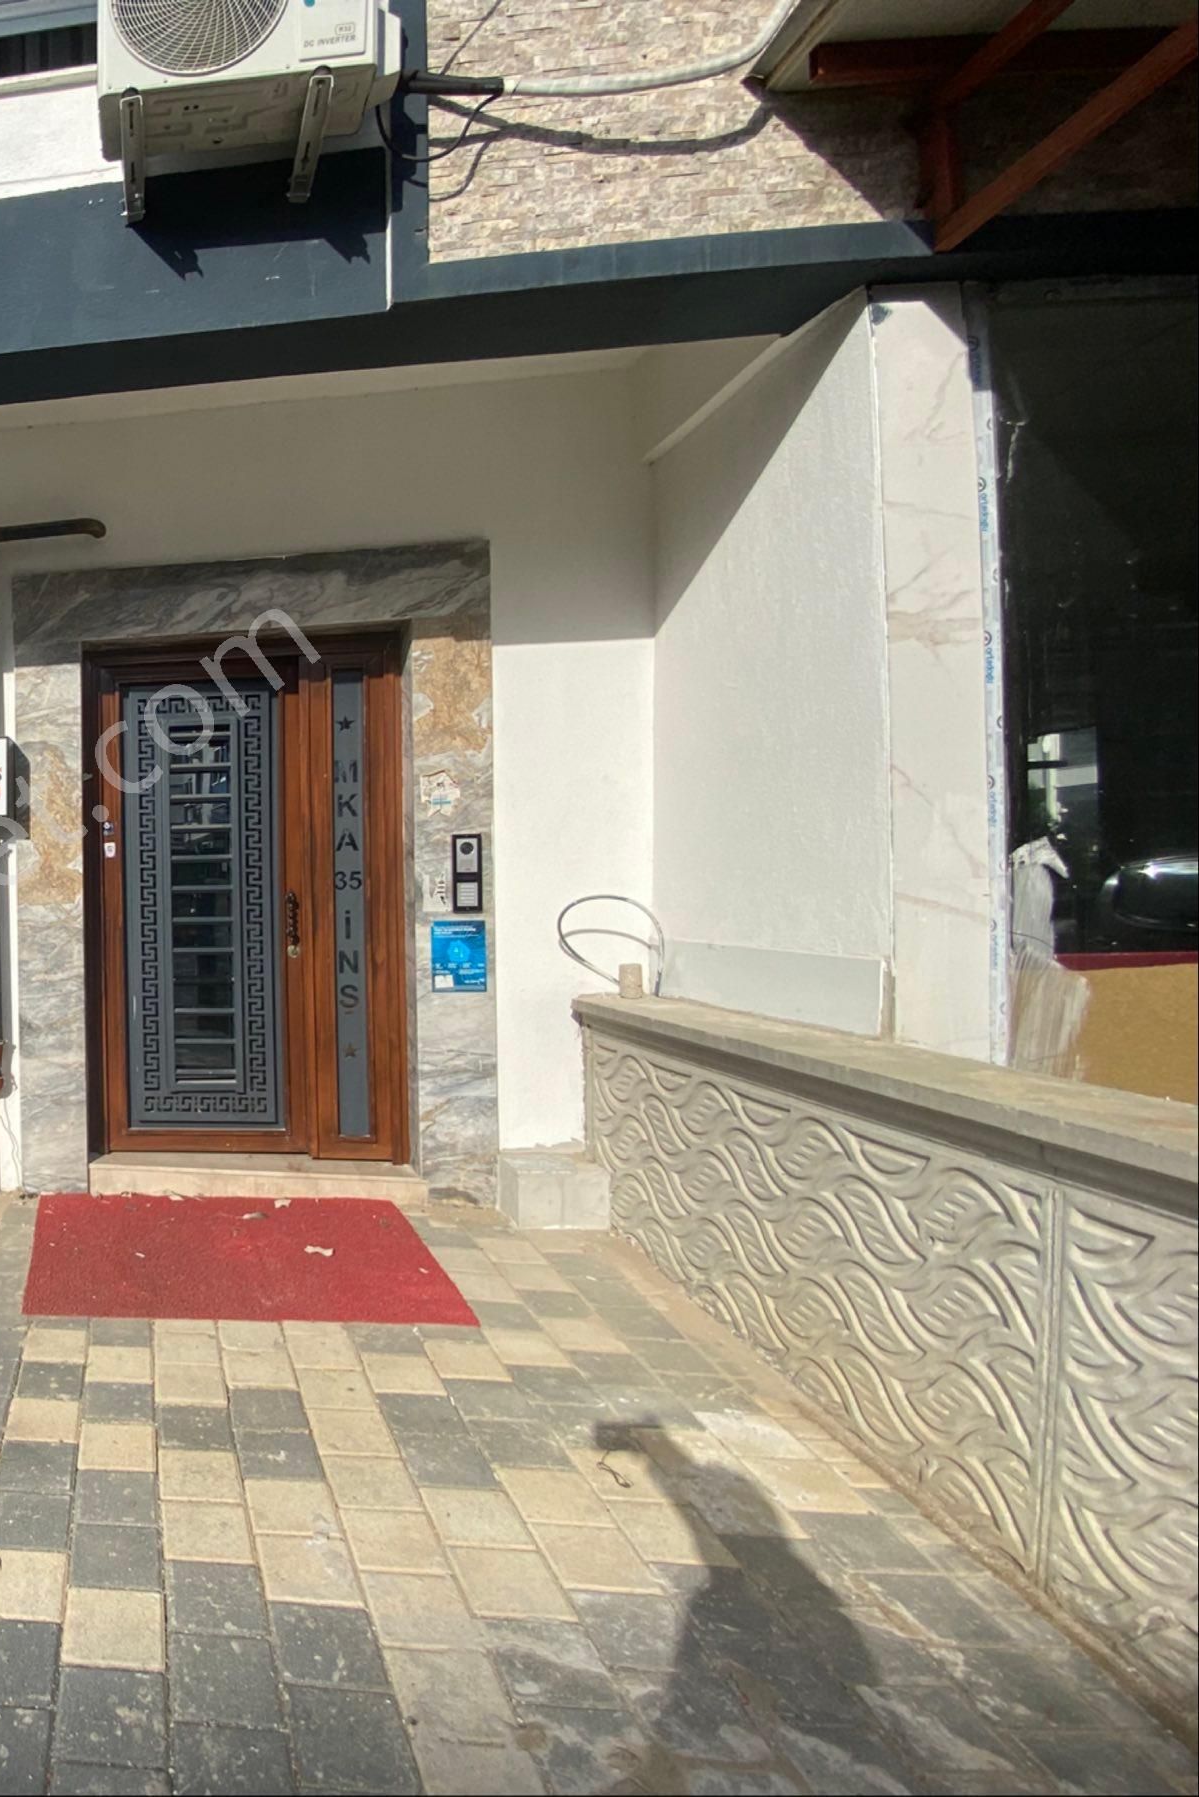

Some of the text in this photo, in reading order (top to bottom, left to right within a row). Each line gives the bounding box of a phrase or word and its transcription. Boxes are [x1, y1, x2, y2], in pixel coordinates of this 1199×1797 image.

[304, 34, 356, 48] DC INVERTER
[334, 868, 363, 890] 35
